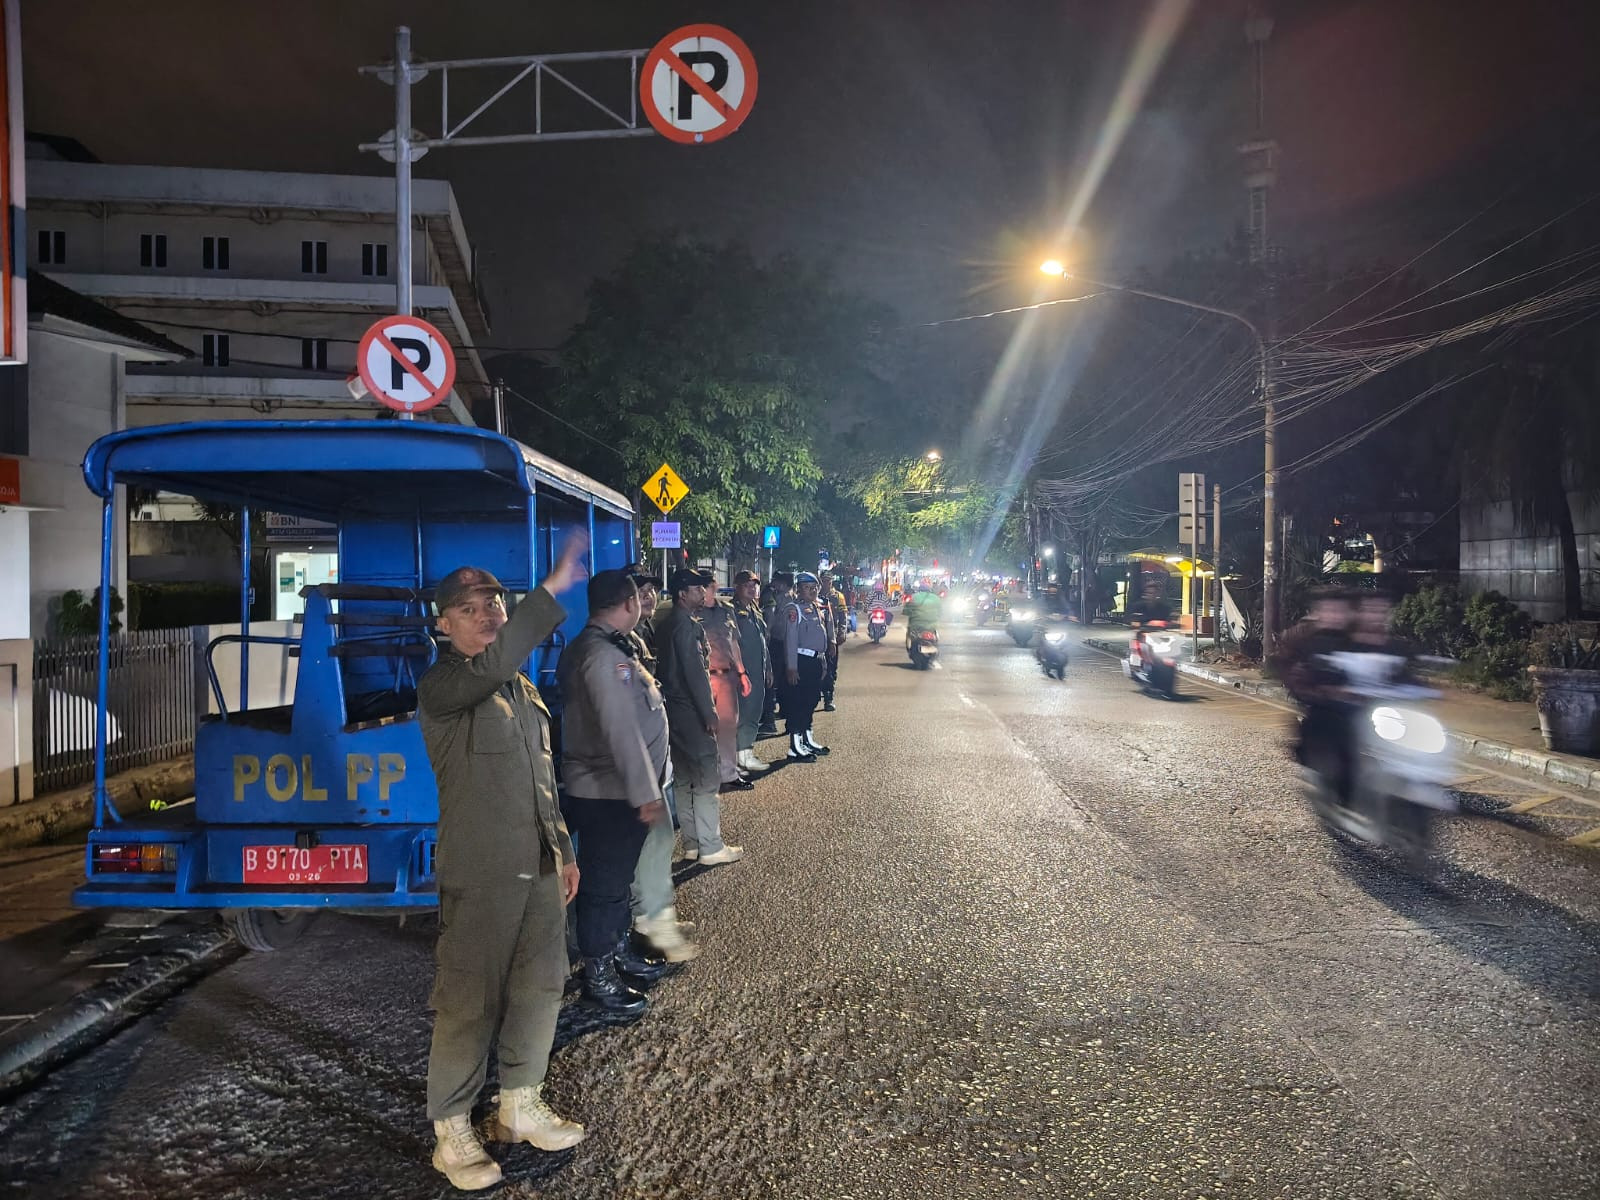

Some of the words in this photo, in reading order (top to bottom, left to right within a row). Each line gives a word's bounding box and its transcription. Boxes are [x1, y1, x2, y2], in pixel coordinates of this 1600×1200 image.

[678, 50, 729, 120] P
[390, 337, 431, 390] P
[280, 516, 300, 526] BNI
[233, 753, 328, 802] POL
[346, 753, 406, 801] PP
[246, 849, 257, 871] B
[266, 848, 310, 870] 9170
[330, 847, 363, 869] PTA
